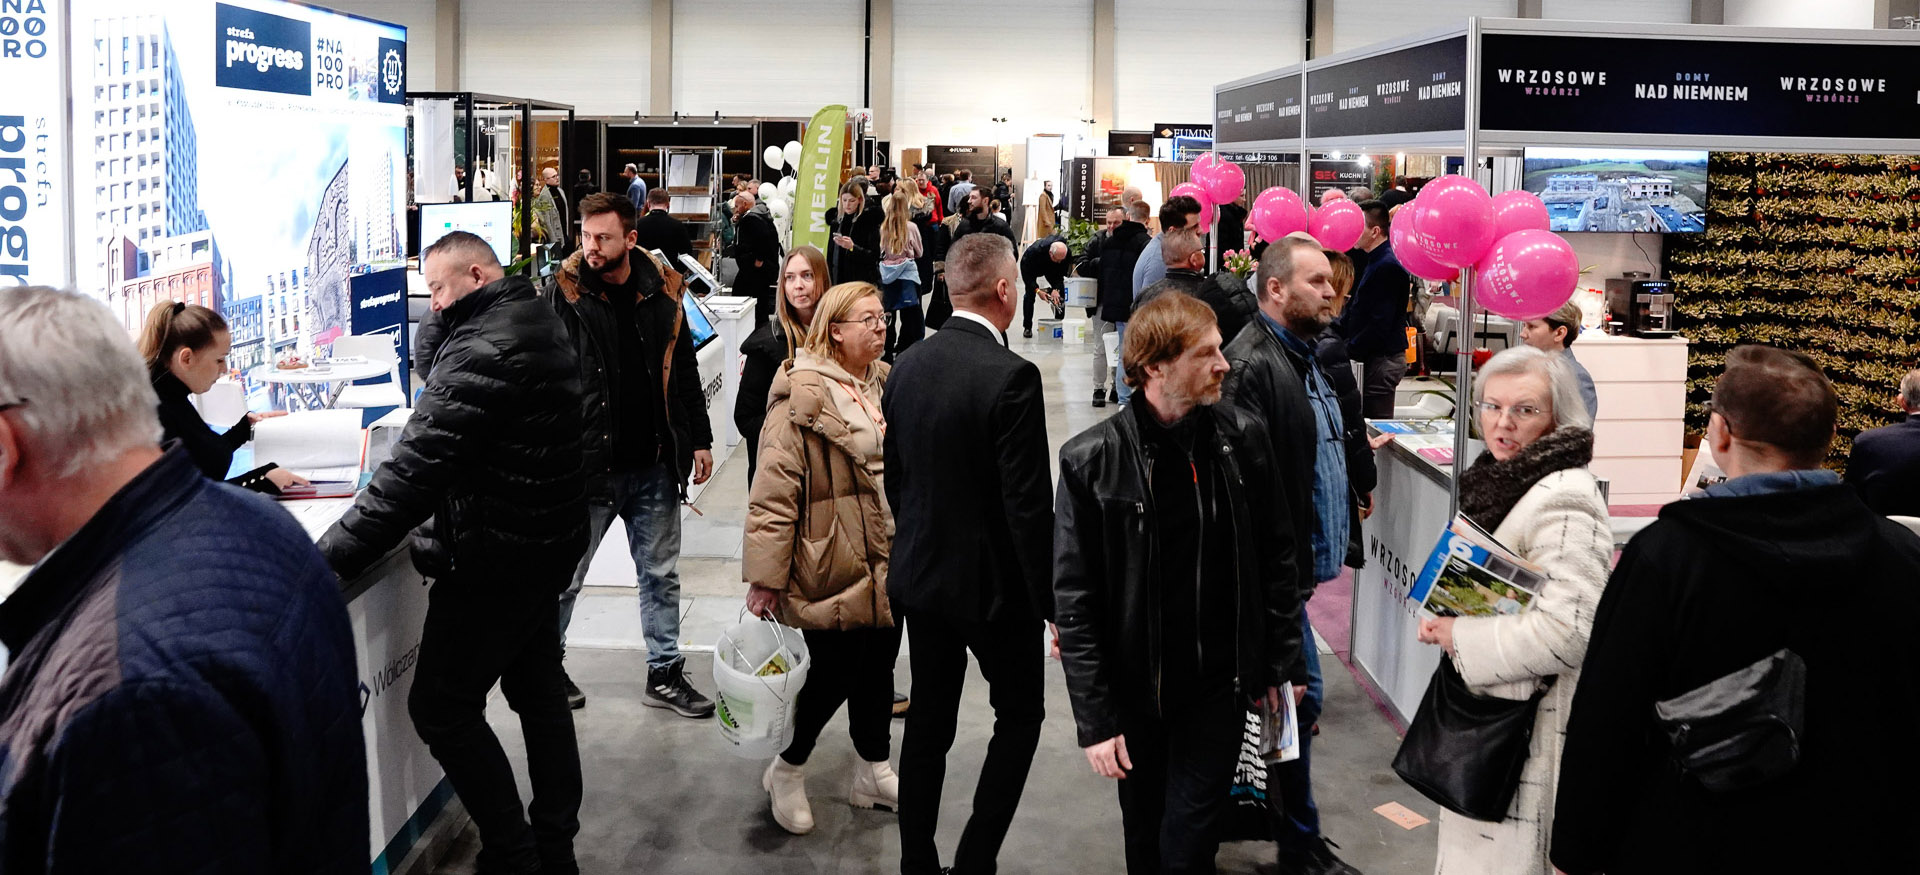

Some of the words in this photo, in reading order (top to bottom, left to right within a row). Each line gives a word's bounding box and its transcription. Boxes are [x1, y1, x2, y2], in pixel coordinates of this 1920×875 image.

[0, 0, 46, 14] NA
[226, 26, 255, 40] strefa
[3, 39, 47, 59] RO
[316, 37, 343, 55] #NA
[225, 39, 304, 73] progress
[316, 73, 344, 90] PRO
[1497, 69, 1607, 86] WRZOSOWE
[1675, 72, 1710, 82] DOMY
[1780, 77, 1886, 93] WRZOSOWE
[1376, 79, 1410, 96] WRZOSOWE
[1418, 86, 1431, 101] NAD
[1635, 83, 1668, 99] NAD
[1673, 84, 1748, 101] NIEMNEM
[36, 117, 52, 208] strefa
[809, 124, 833, 233] MERLIN
[1370, 533, 1417, 591] WRZOSO
